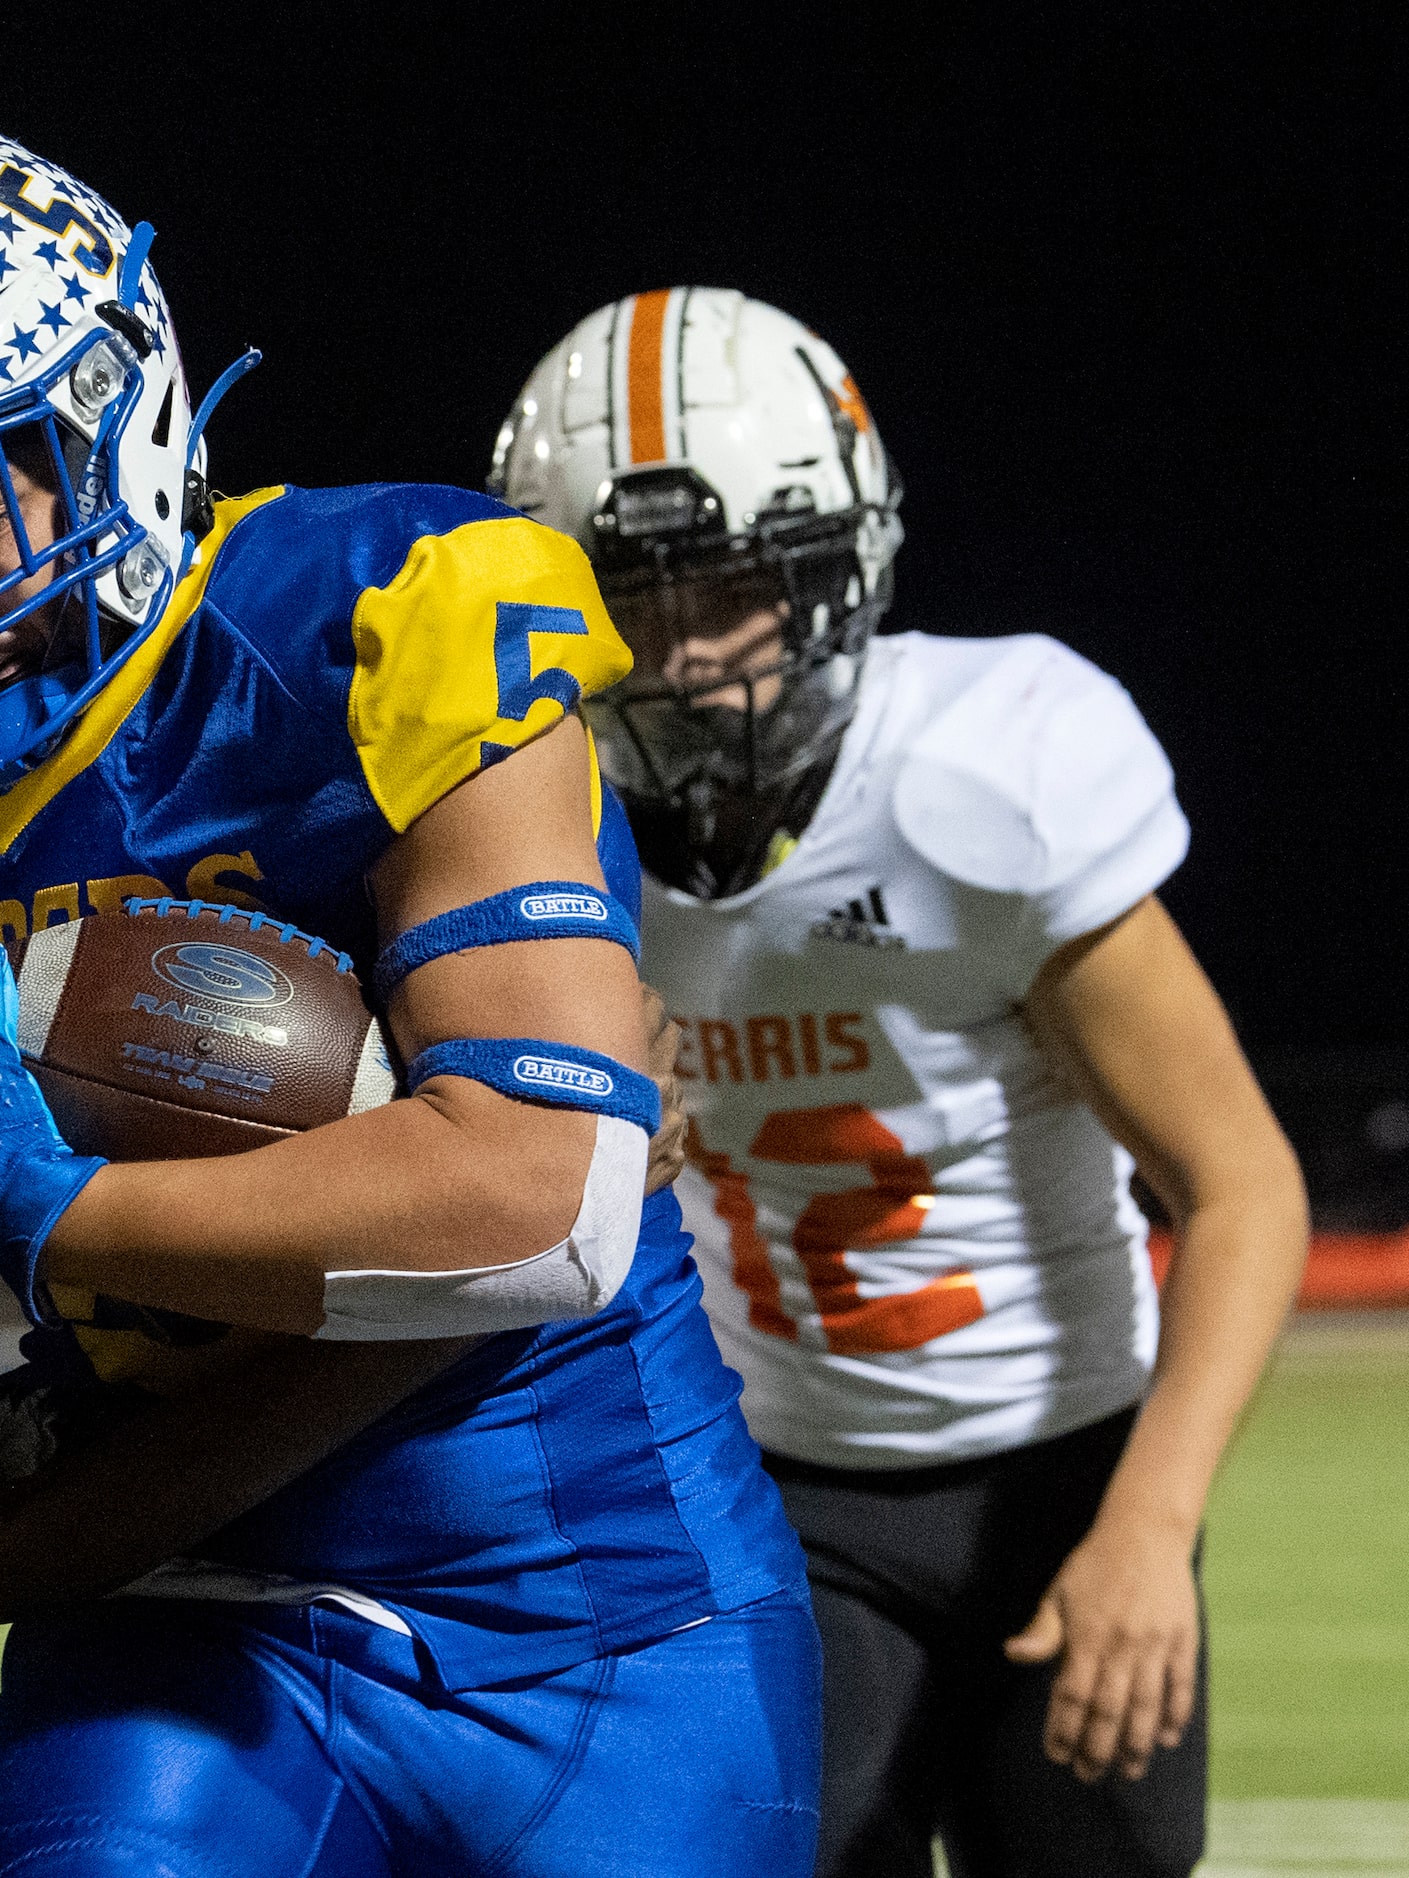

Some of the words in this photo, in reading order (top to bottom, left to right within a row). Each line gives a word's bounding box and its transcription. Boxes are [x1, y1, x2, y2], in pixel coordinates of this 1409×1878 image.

[480, 601, 589, 767] 5
[530, 900, 602, 916] BATTLE
[131, 992, 289, 1047] RAIDERS
[522, 1060, 605, 1091] BATTLE
[686, 1103, 985, 1355] 12
